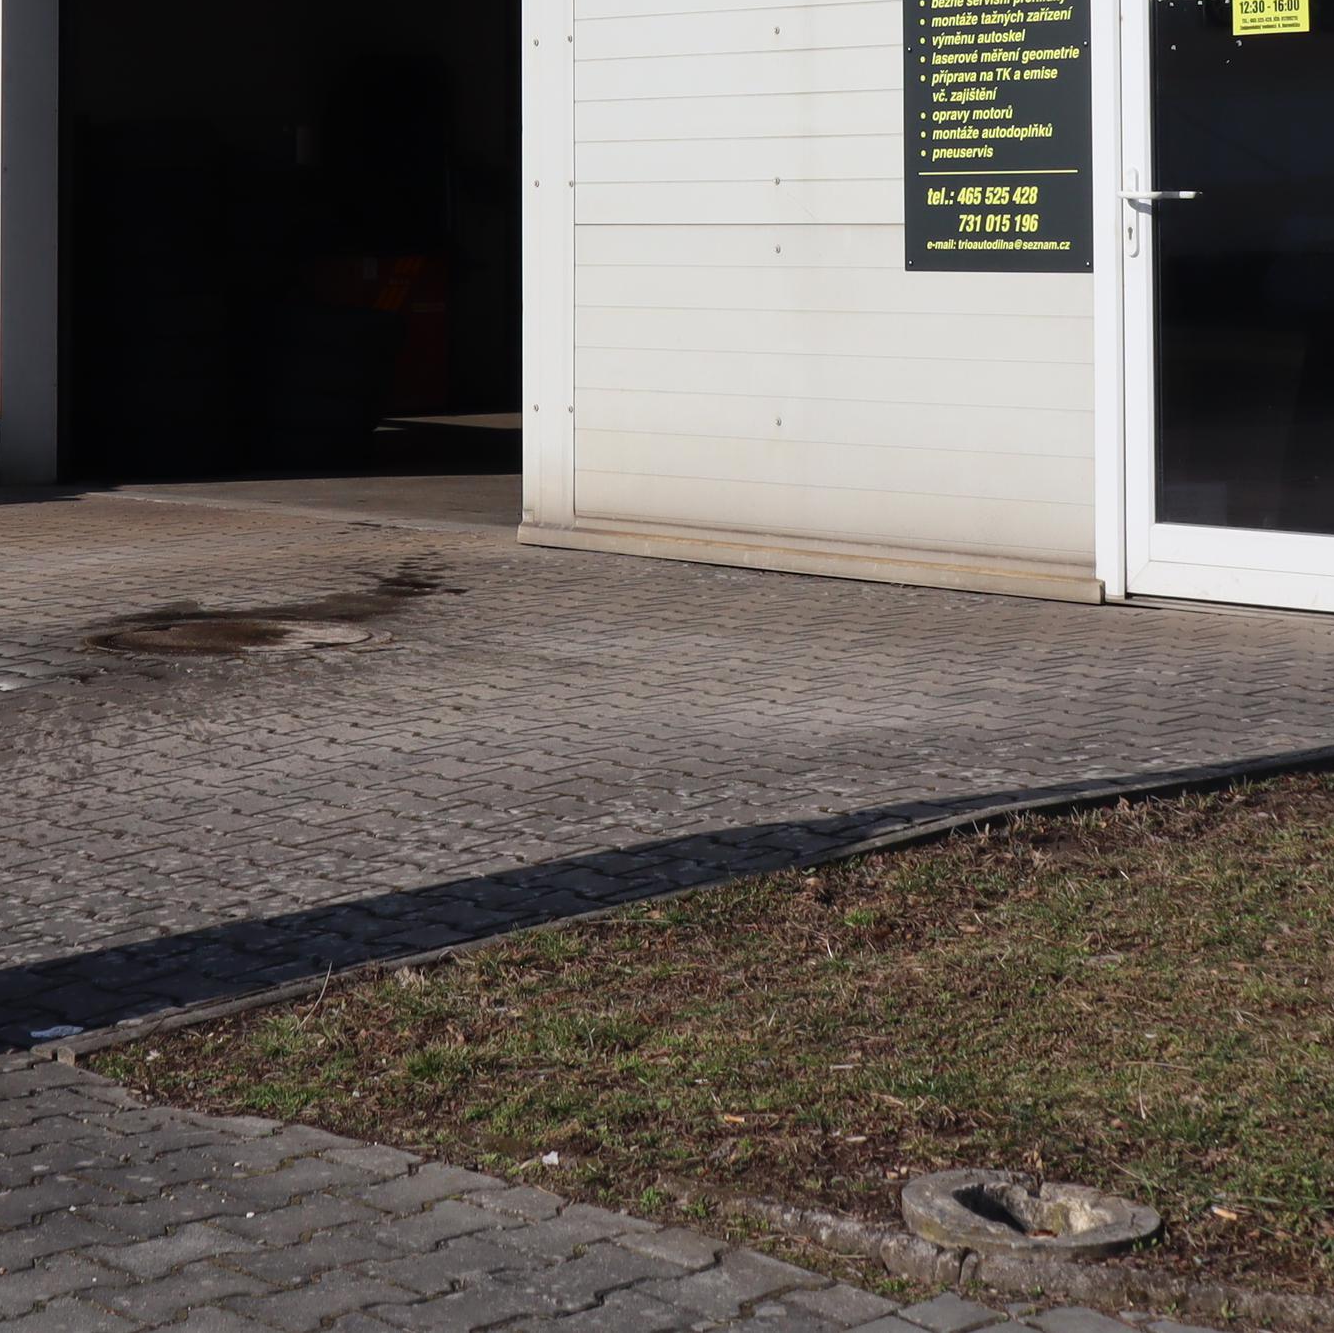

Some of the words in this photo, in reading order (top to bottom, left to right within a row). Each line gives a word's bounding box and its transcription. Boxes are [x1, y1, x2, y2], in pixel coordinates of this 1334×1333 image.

[1239, 0, 1265, 14] 12:30
[931, 11, 978, 28] montáže
[980, 10, 1024, 27] tažných
[1026, 6, 1073, 23] zařízení
[932, 32, 975, 49] výměnu
[977, 28, 1026, 44] autoskel
[932, 49, 978, 65] laserové
[980, 47, 1020, 63] měření
[1022, 46, 1080, 64] geometrie
[931, 69, 977, 87] příprava
[979, 71, 994, 82] na
[995, 67, 1012, 81] TK
[1014, 70, 1021, 80] a
[1023, 66, 1058, 80] emise
[932, 88, 948, 103] vč.
[950, 87, 998, 105] zajištění
[932, 107, 969, 124] opravy
[972, 105, 1013, 121] motorů
[932, 125, 980, 140] montáže
[982, 123, 1053, 140] autodoplňků
[932, 144, 994, 161] pneuservis
[927, 186, 954, 205] tel.:
[957, 187, 982, 205] 465
[985, 186, 1011, 205] 525
[1012, 186, 1038, 204] 428
[958, 214, 982, 232] 731
[985, 214, 1011, 232] 015
[1014, 214, 1039, 232] 196
[927, 238, 956, 250] e-mail:
